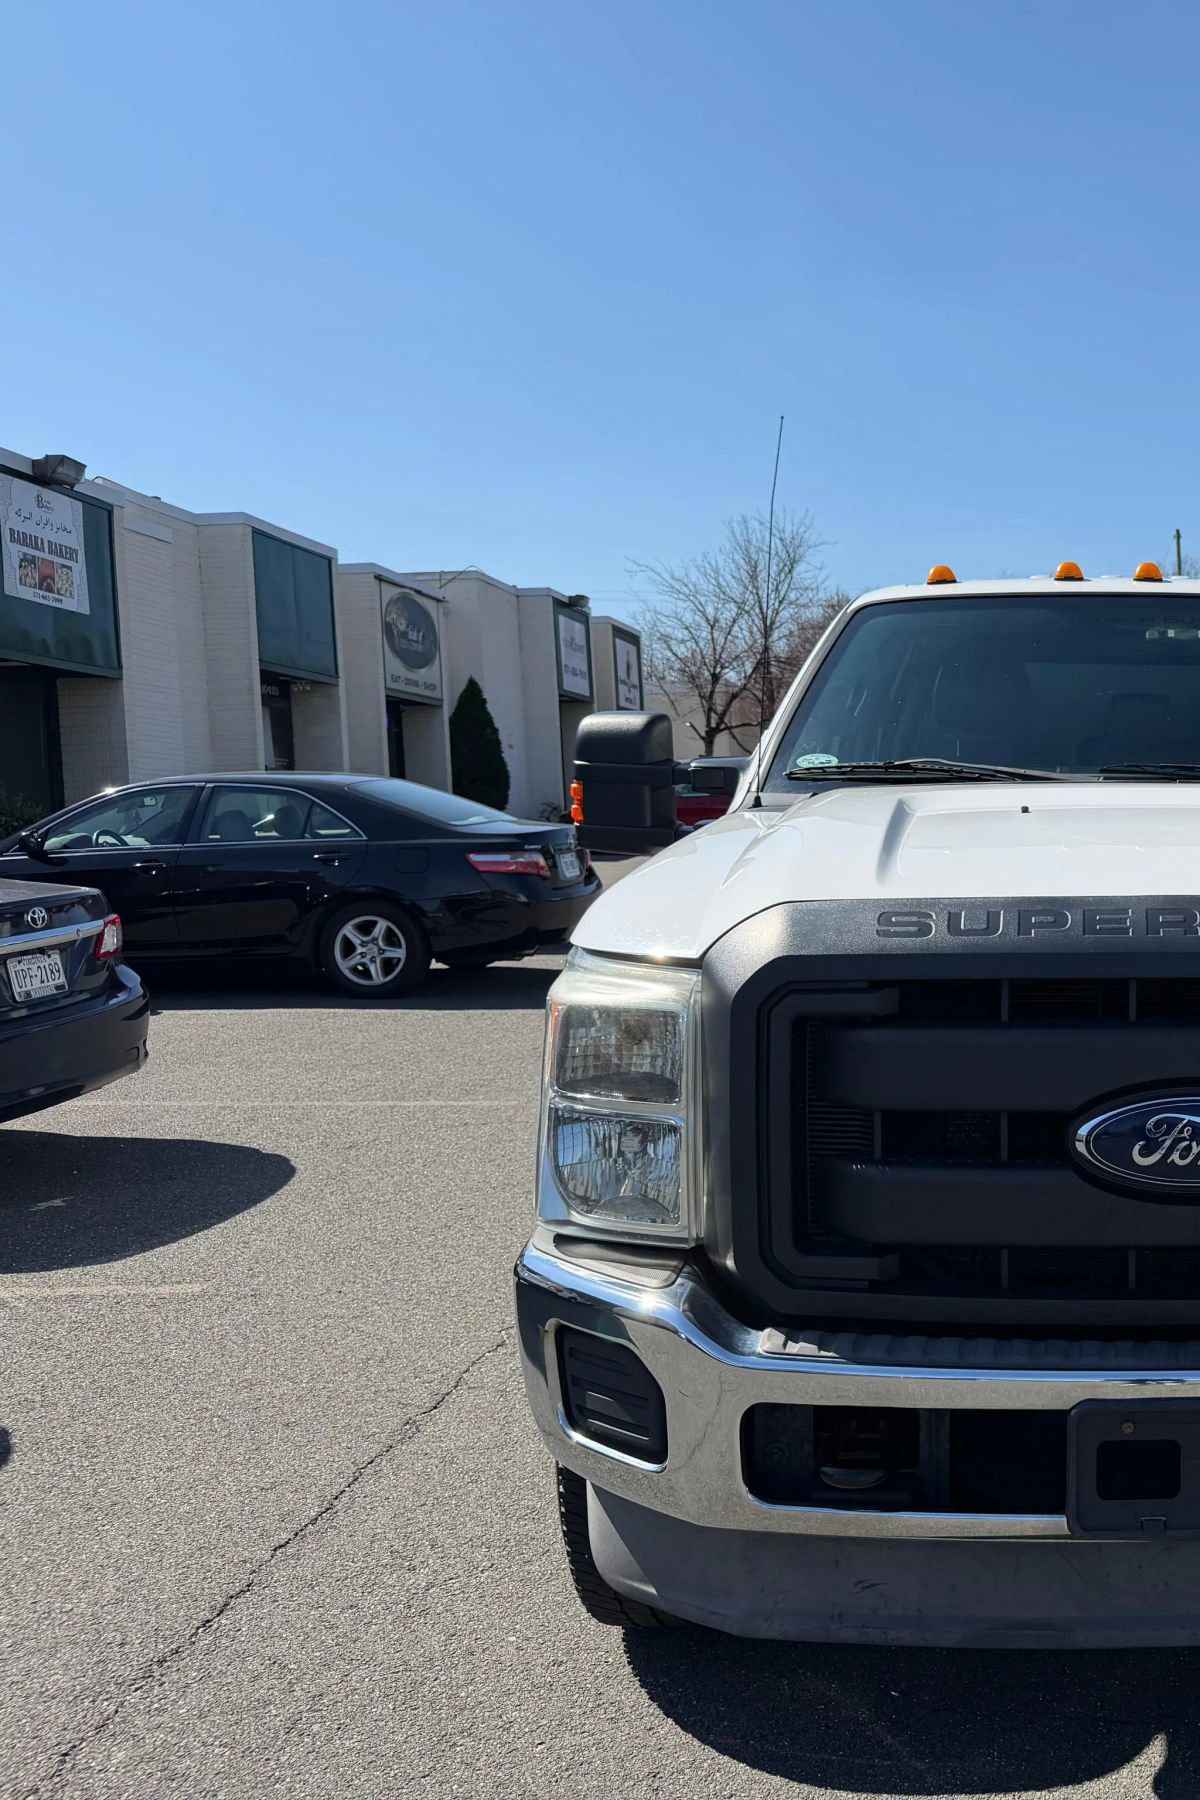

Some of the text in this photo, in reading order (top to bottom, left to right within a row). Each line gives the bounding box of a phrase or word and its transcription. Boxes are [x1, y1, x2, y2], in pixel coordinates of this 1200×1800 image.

[8, 527, 79, 564] BARAKA BAKERY
[391, 674, 401, 683] EAT
[14, 962, 62, 989] UPF-2189
